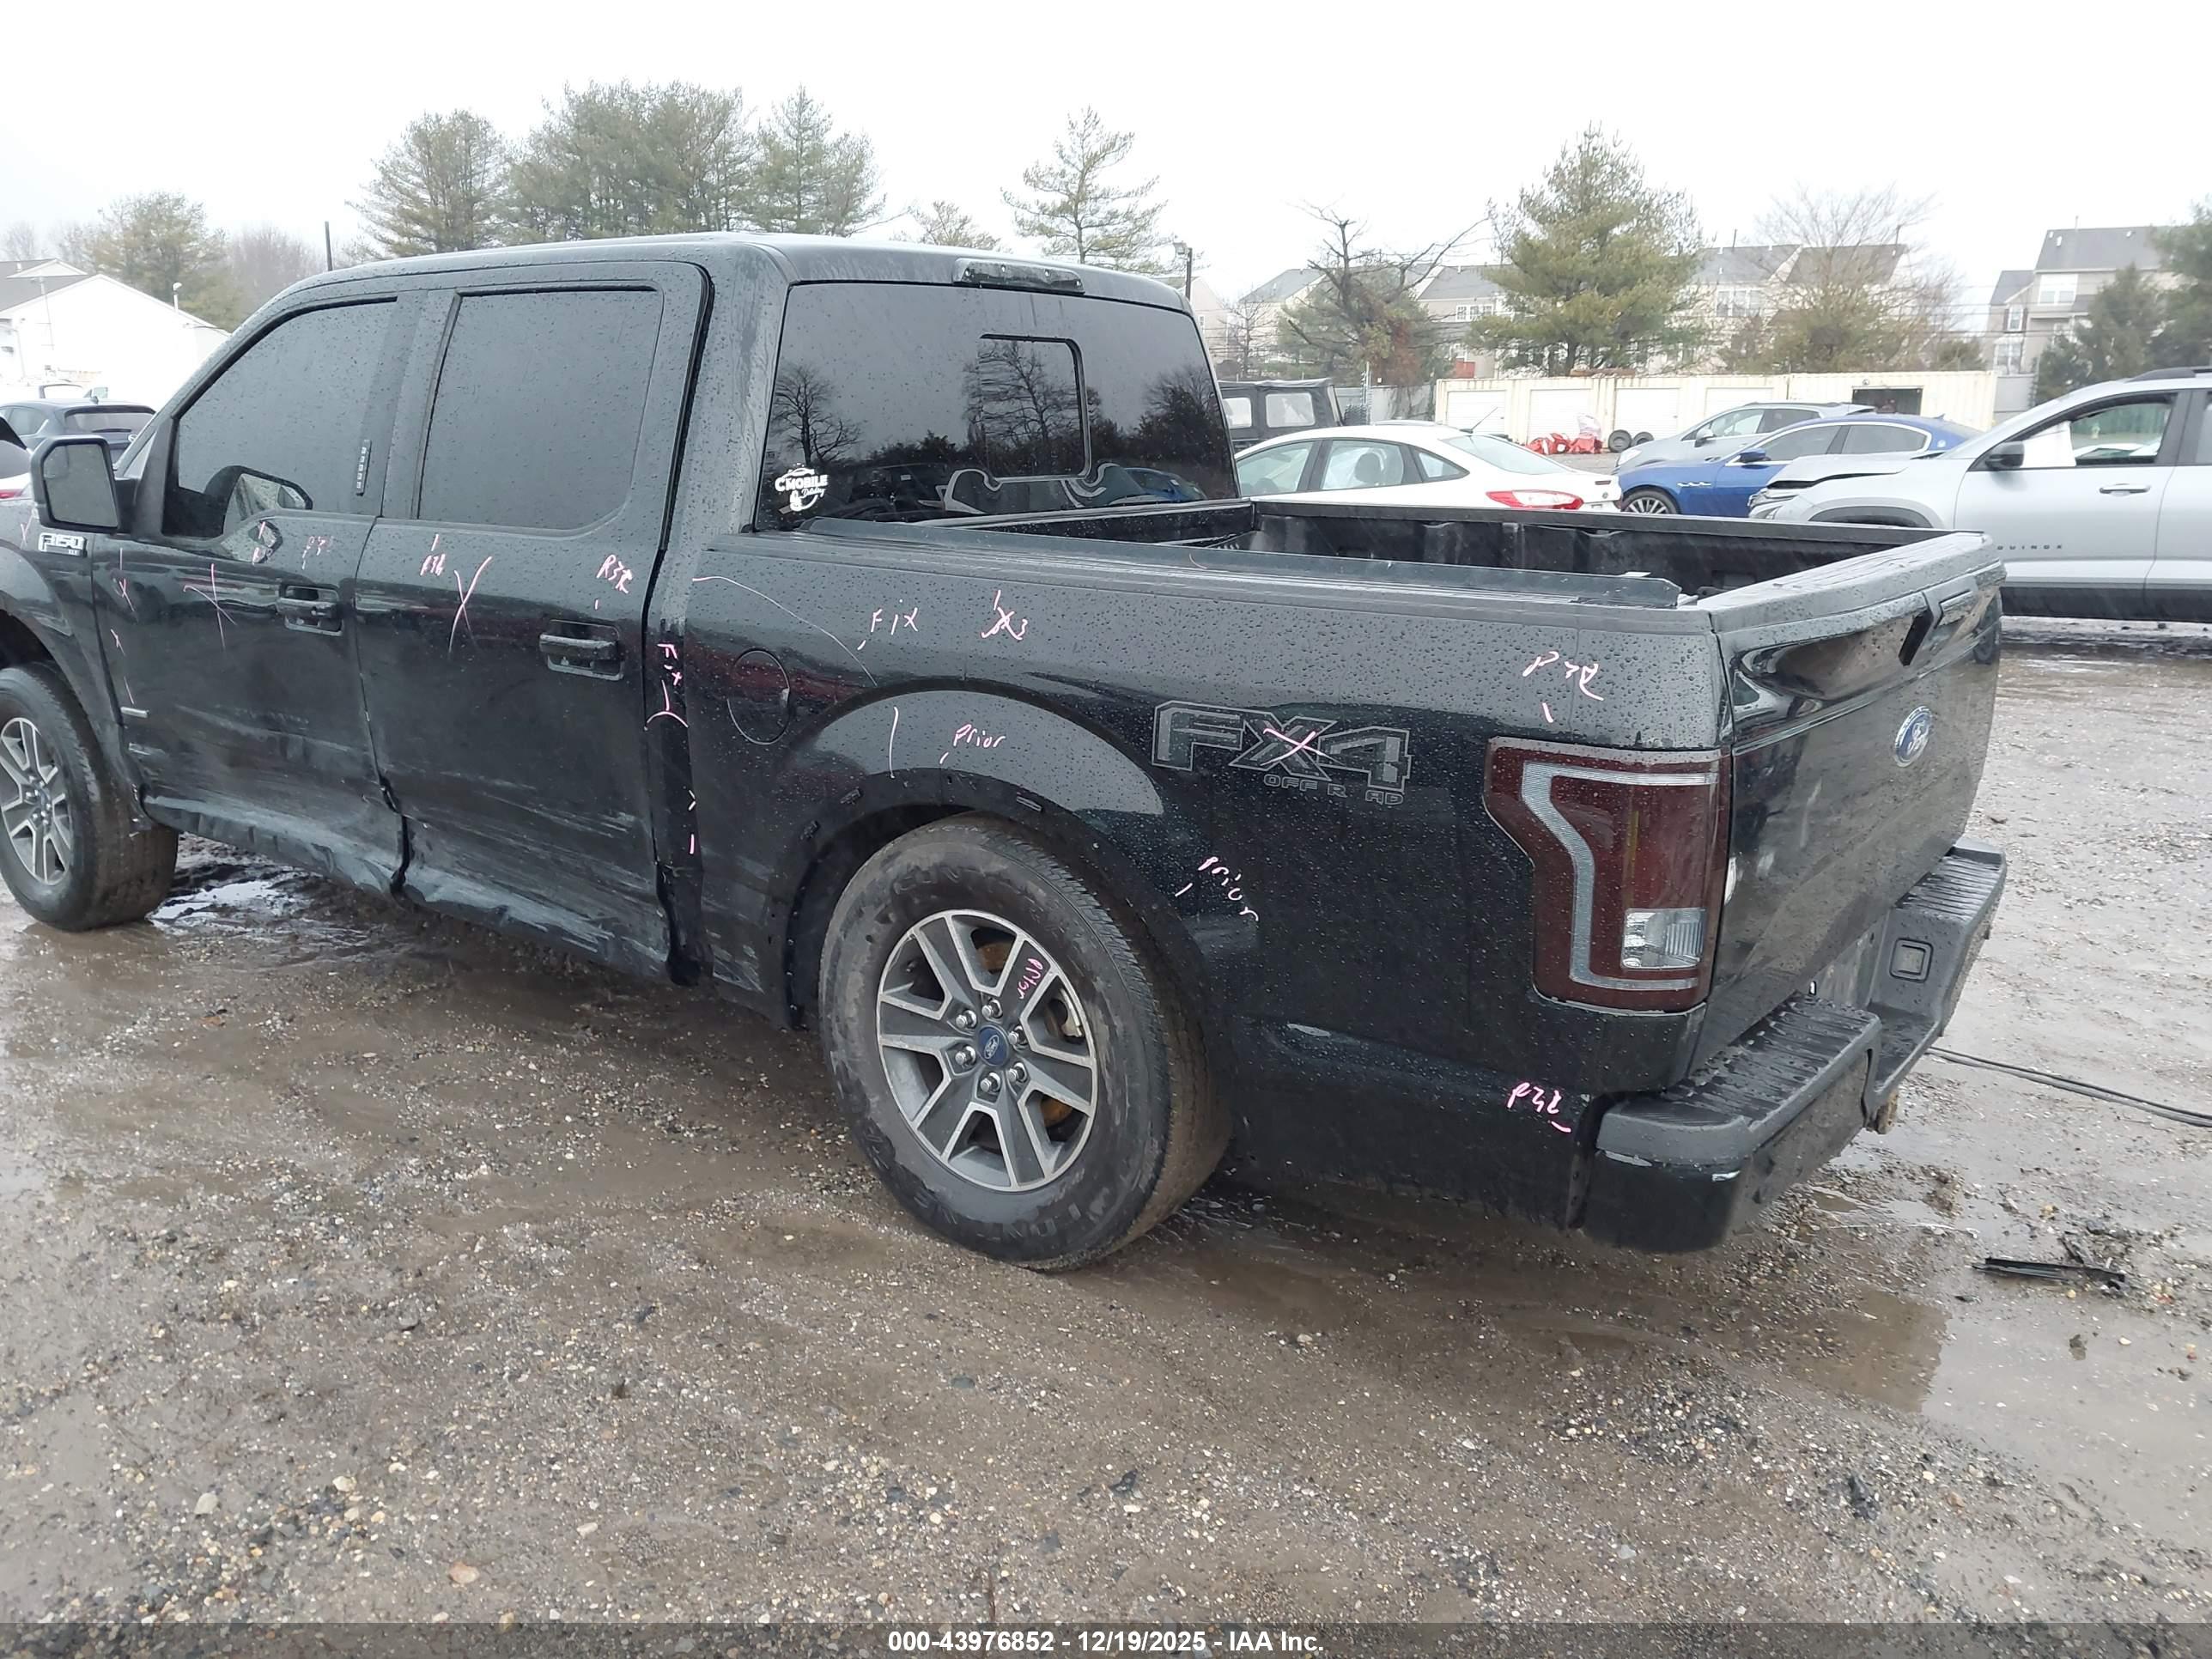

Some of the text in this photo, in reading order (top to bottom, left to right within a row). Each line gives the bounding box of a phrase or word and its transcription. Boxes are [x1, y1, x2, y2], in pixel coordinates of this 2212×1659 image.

[1152, 700, 1412, 795] FX4
[1264, 774, 1405, 806] OFF RAD
